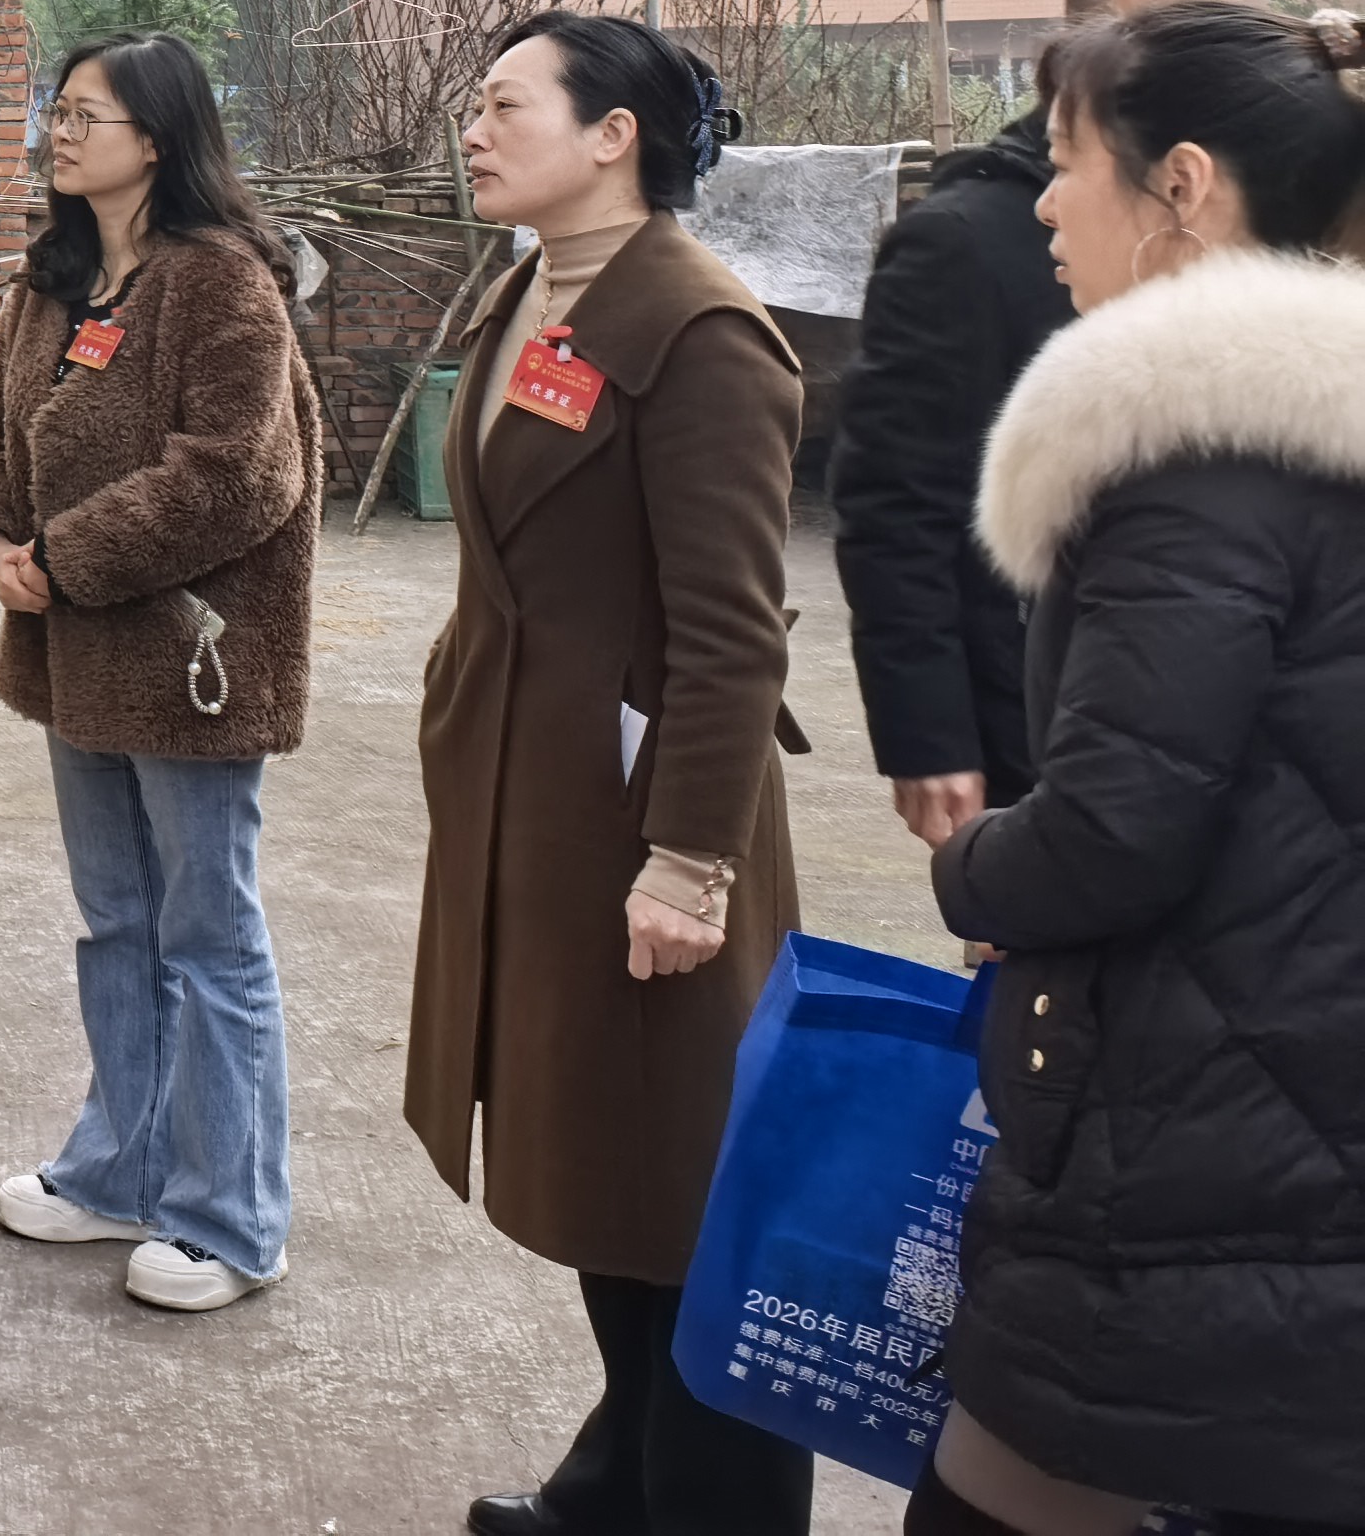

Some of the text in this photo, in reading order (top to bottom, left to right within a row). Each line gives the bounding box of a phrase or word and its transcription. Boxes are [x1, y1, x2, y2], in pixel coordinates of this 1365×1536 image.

[529, 382, 571, 408] 代表证
[952, 1138, 989, 1166] 中
